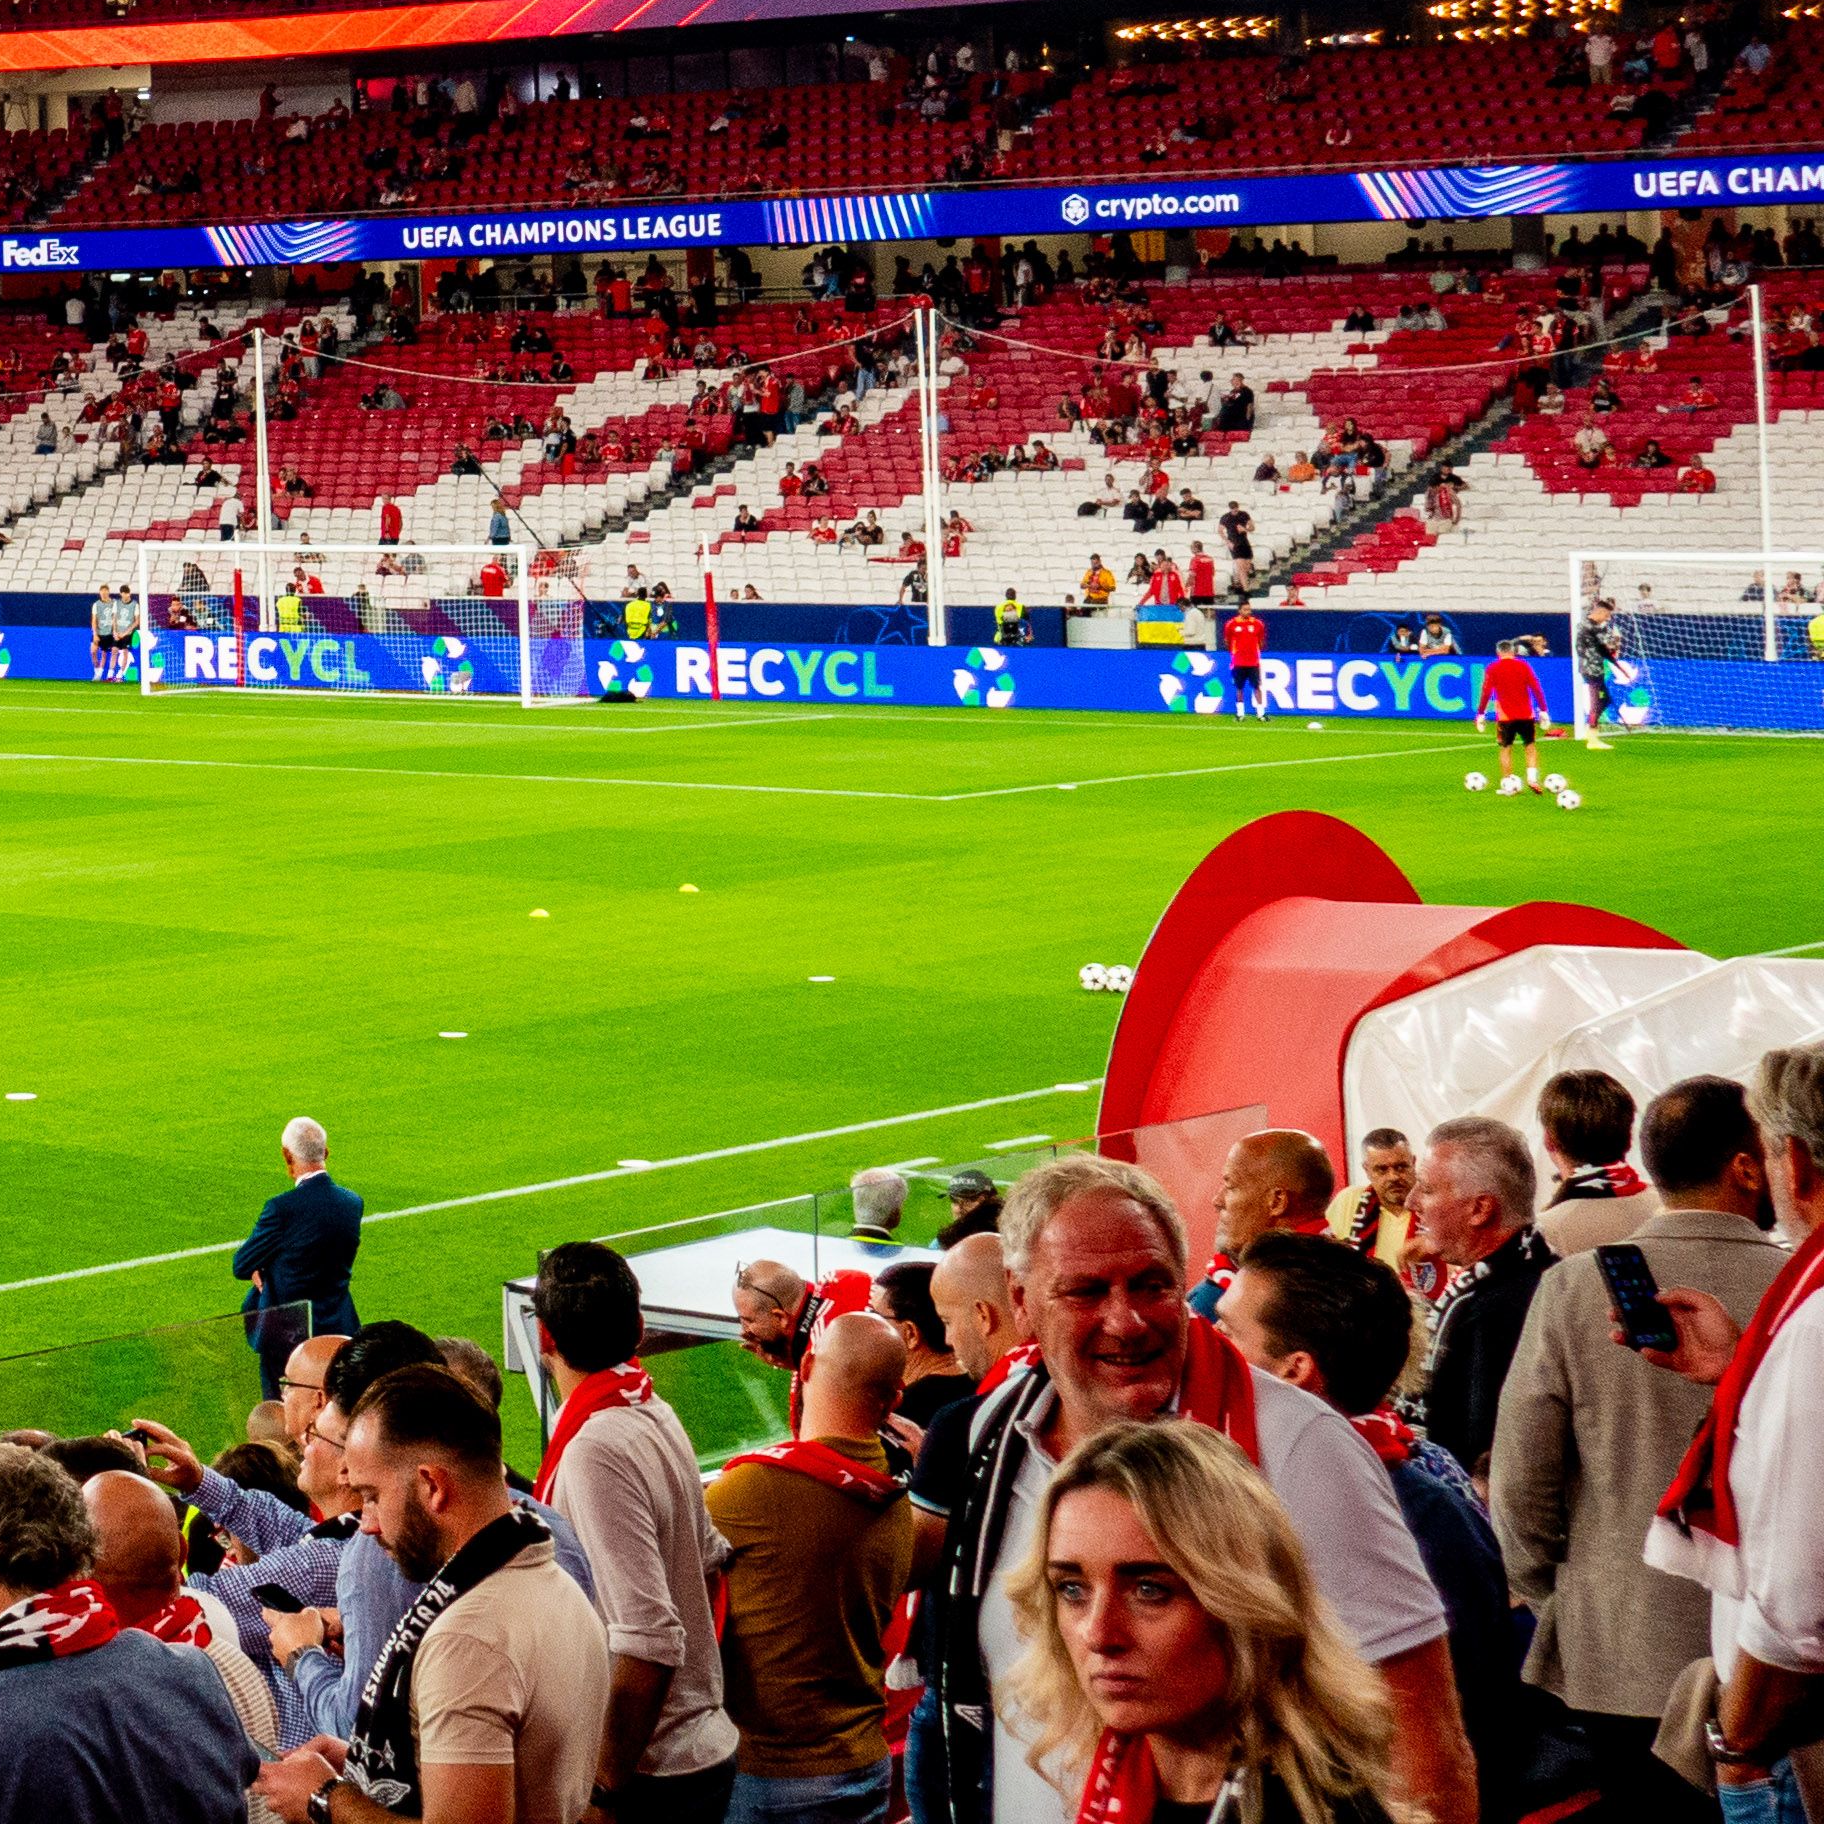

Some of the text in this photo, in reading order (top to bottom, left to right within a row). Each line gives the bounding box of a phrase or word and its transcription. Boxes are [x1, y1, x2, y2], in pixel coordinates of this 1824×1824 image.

[1635, 170, 1720, 198] UEFA
[1095, 192, 1239, 220] crypto.com
[403, 214, 722, 249] UEFA CHAMPIONS LEAGUE
[2, 238, 80, 267] FedEx
[184, 635, 371, 682] RECYCL
[675, 646, 894, 697] RECYCL
